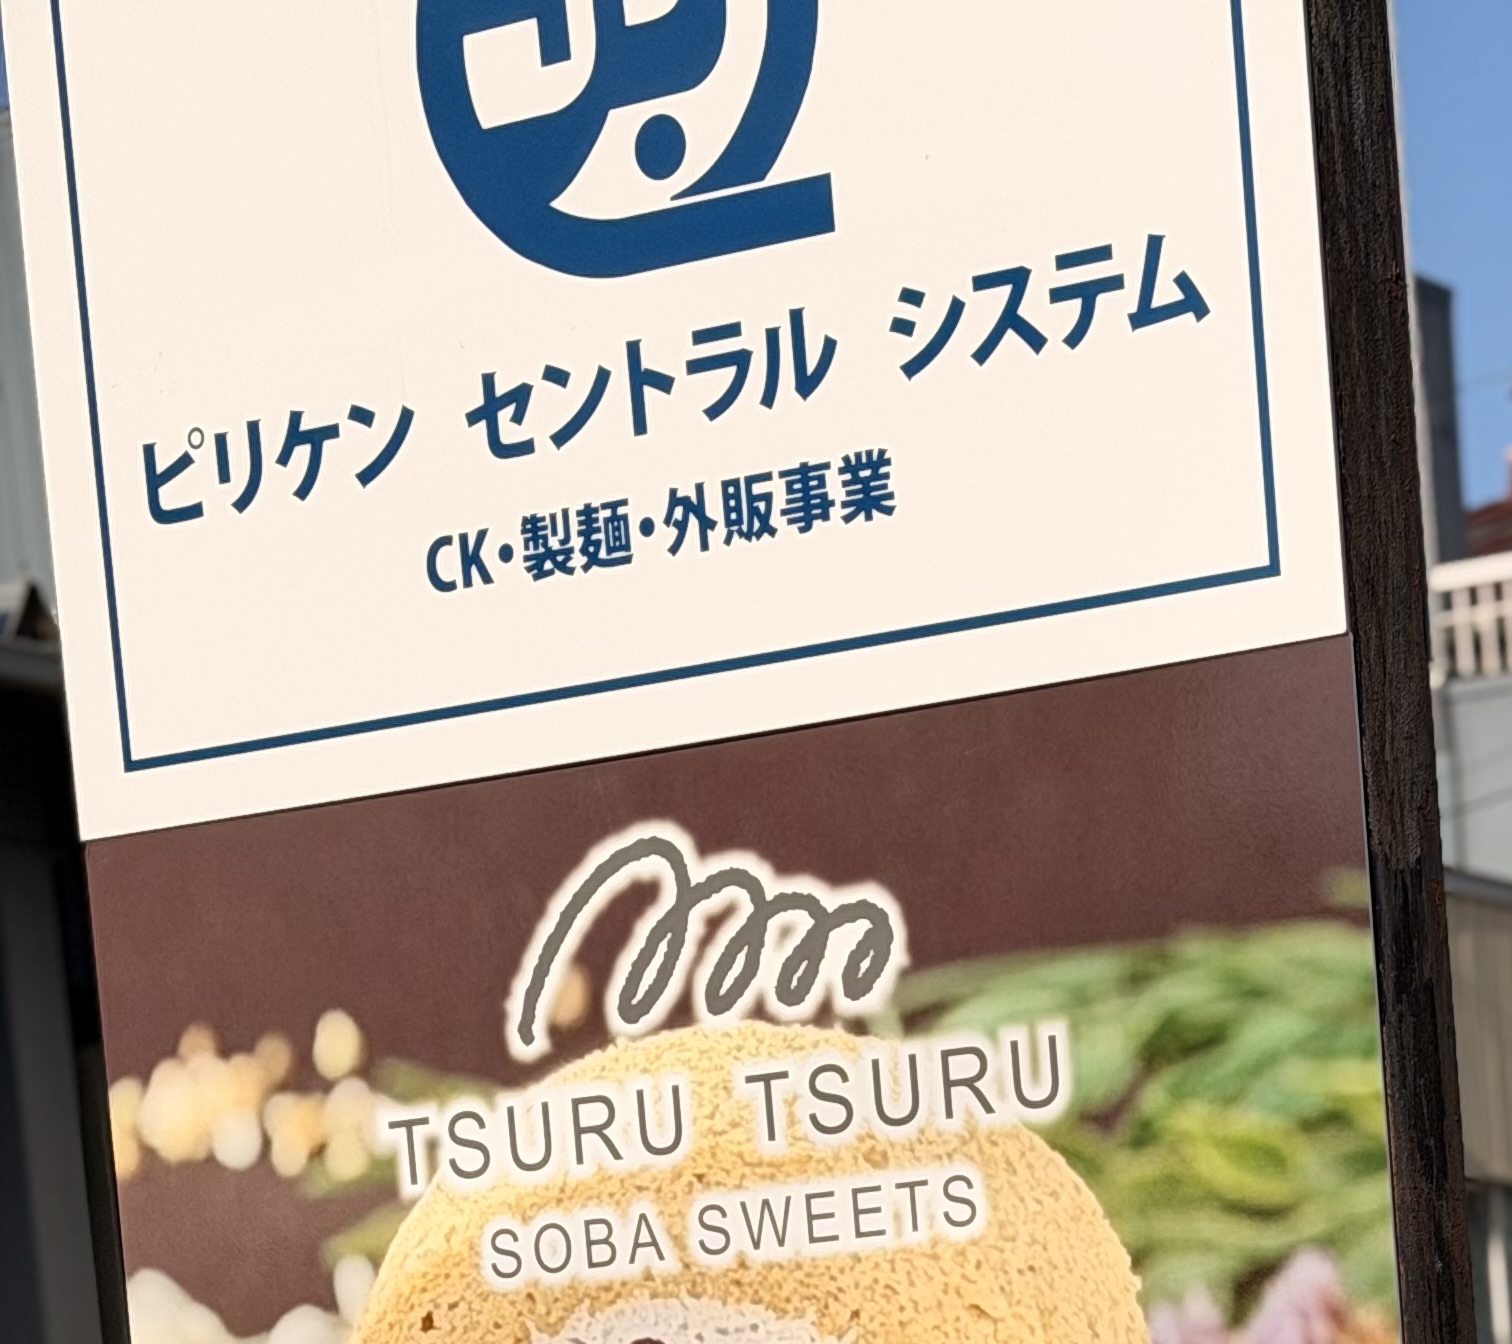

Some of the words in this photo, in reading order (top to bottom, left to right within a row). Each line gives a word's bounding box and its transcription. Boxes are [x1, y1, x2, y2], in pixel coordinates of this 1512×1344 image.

[142, 403, 416, 526] ピリケン
[465, 307, 838, 461] セントラル
[888, 234, 1211, 381] システム
[387, 1083, 685, 1187] TSURU
[744, 1034, 1063, 1143] TSURU
[489, 1211, 667, 1279] SOBA
[697, 1173, 980, 1257] SWEETS
